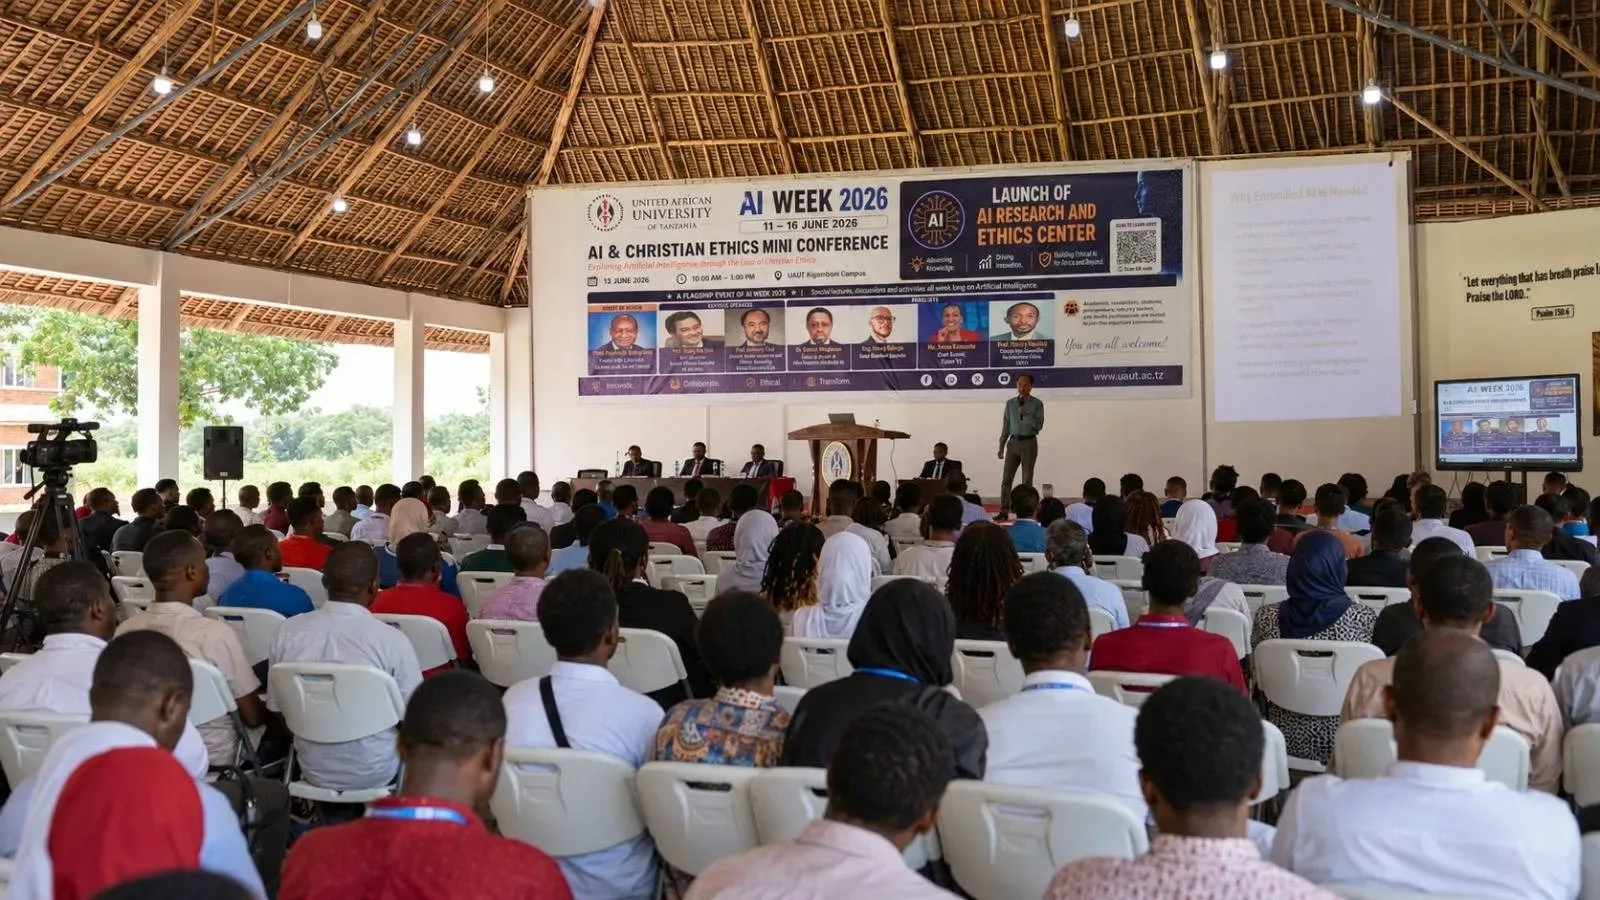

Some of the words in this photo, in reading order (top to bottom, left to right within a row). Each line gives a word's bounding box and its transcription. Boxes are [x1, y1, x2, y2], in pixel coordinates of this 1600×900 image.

[993, 185, 1048, 203] LAUNCH
[1054, 184, 1071, 200] OF
[632, 199, 668, 207] UNITED
[671, 197, 712, 205] AFRICAN
[740, 191, 763, 215] AI
[773, 189, 833, 213] WEEK
[840, 187, 888, 211] 2026
[632, 208, 712, 220] UNIVERSITY
[977, 208, 991, 224] AI
[997, 204, 1064, 223] RESEARCH
[1068, 203, 1096, 220] AND
[660, 222, 697, 230] TANZANIA
[764, 222, 773, 230] 11
[787, 221, 798, 229] 16
[802, 220, 828, 229] JUNE
[832, 219, 858, 228] 2026
[928, 213, 943, 227] AI
[978, 227, 1033, 246] ETHICS
[1038, 224, 1096, 243] CENTER
[588, 245, 602, 260] AI
[608, 245, 620, 258] &
[626, 242, 704, 258] CHRISTIAN
[710, 240, 758, 255] ETHICS
[763, 239, 791, 254] MINI
[797, 235, 888, 252] CONFERENCE
[588, 262, 620, 272] Exploring
[841, 270, 865, 279] Campus
[1481, 274, 1517, 287] everything
[1519, 272, 1533, 283] that
[1535, 271, 1548, 281] has
[1549, 267, 1571, 280] breath
[1573, 265, 1594, 280] praise
[952, 284, 965, 292] long
[976, 282, 1001, 290] Artificial
[1466, 292, 1490, 303] Praise
[1492, 291, 1504, 301] the
[1064, 337, 1082, 356] You
[1087, 341, 1102, 349] are
[1105, 336, 1120, 349] all
[1122, 336, 1168, 349] welcome!
[1093, 372, 1163, 380] www.uaut.ac.tz
